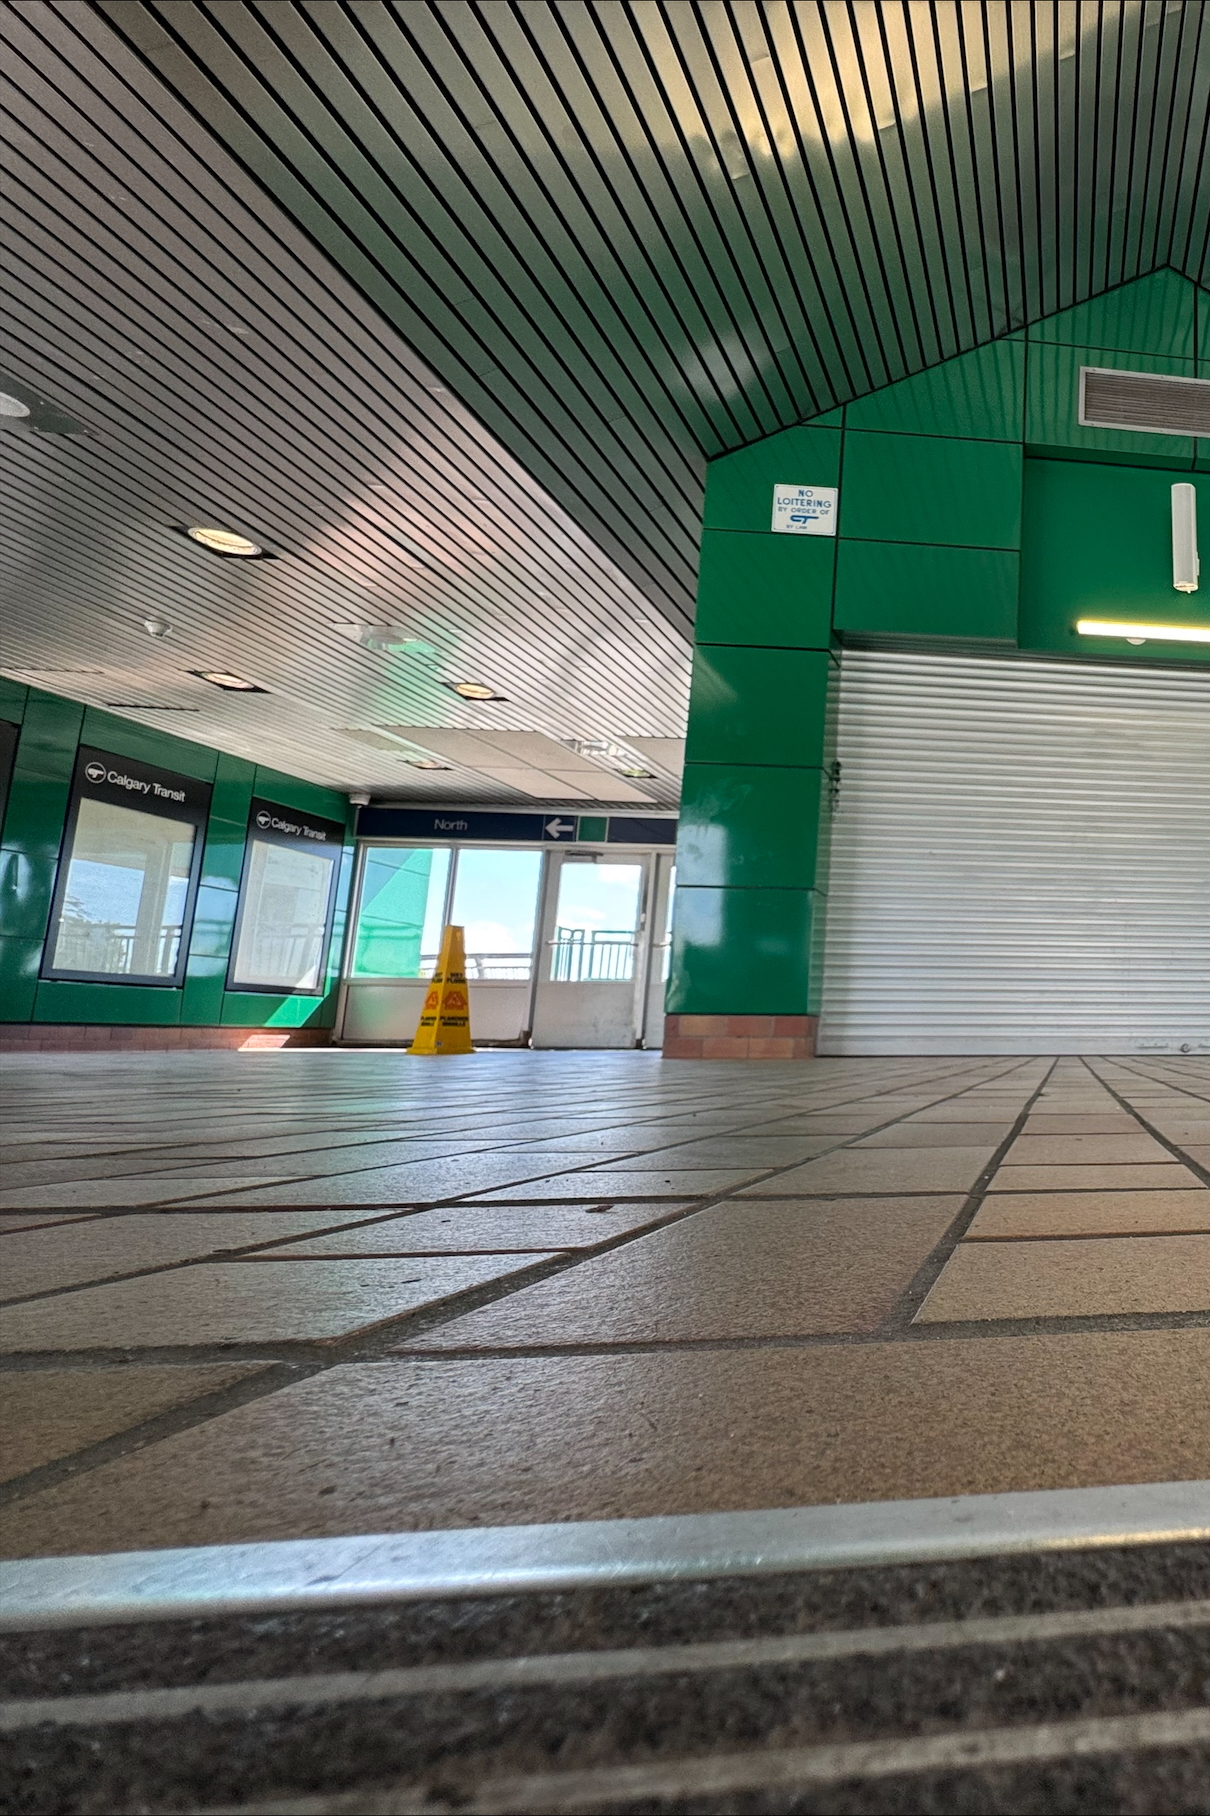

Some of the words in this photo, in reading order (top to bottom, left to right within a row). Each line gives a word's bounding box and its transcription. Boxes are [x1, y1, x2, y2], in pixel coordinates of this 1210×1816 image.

[798, 489, 814, 498] NO
[777, 497, 832, 509] LOITERING
[107, 771, 151, 794] Calgary
[152, 783, 186, 803] Transit
[271, 817, 302, 836] Calgary
[302, 825, 327, 841] Transit
[433, 818, 468, 831] North
